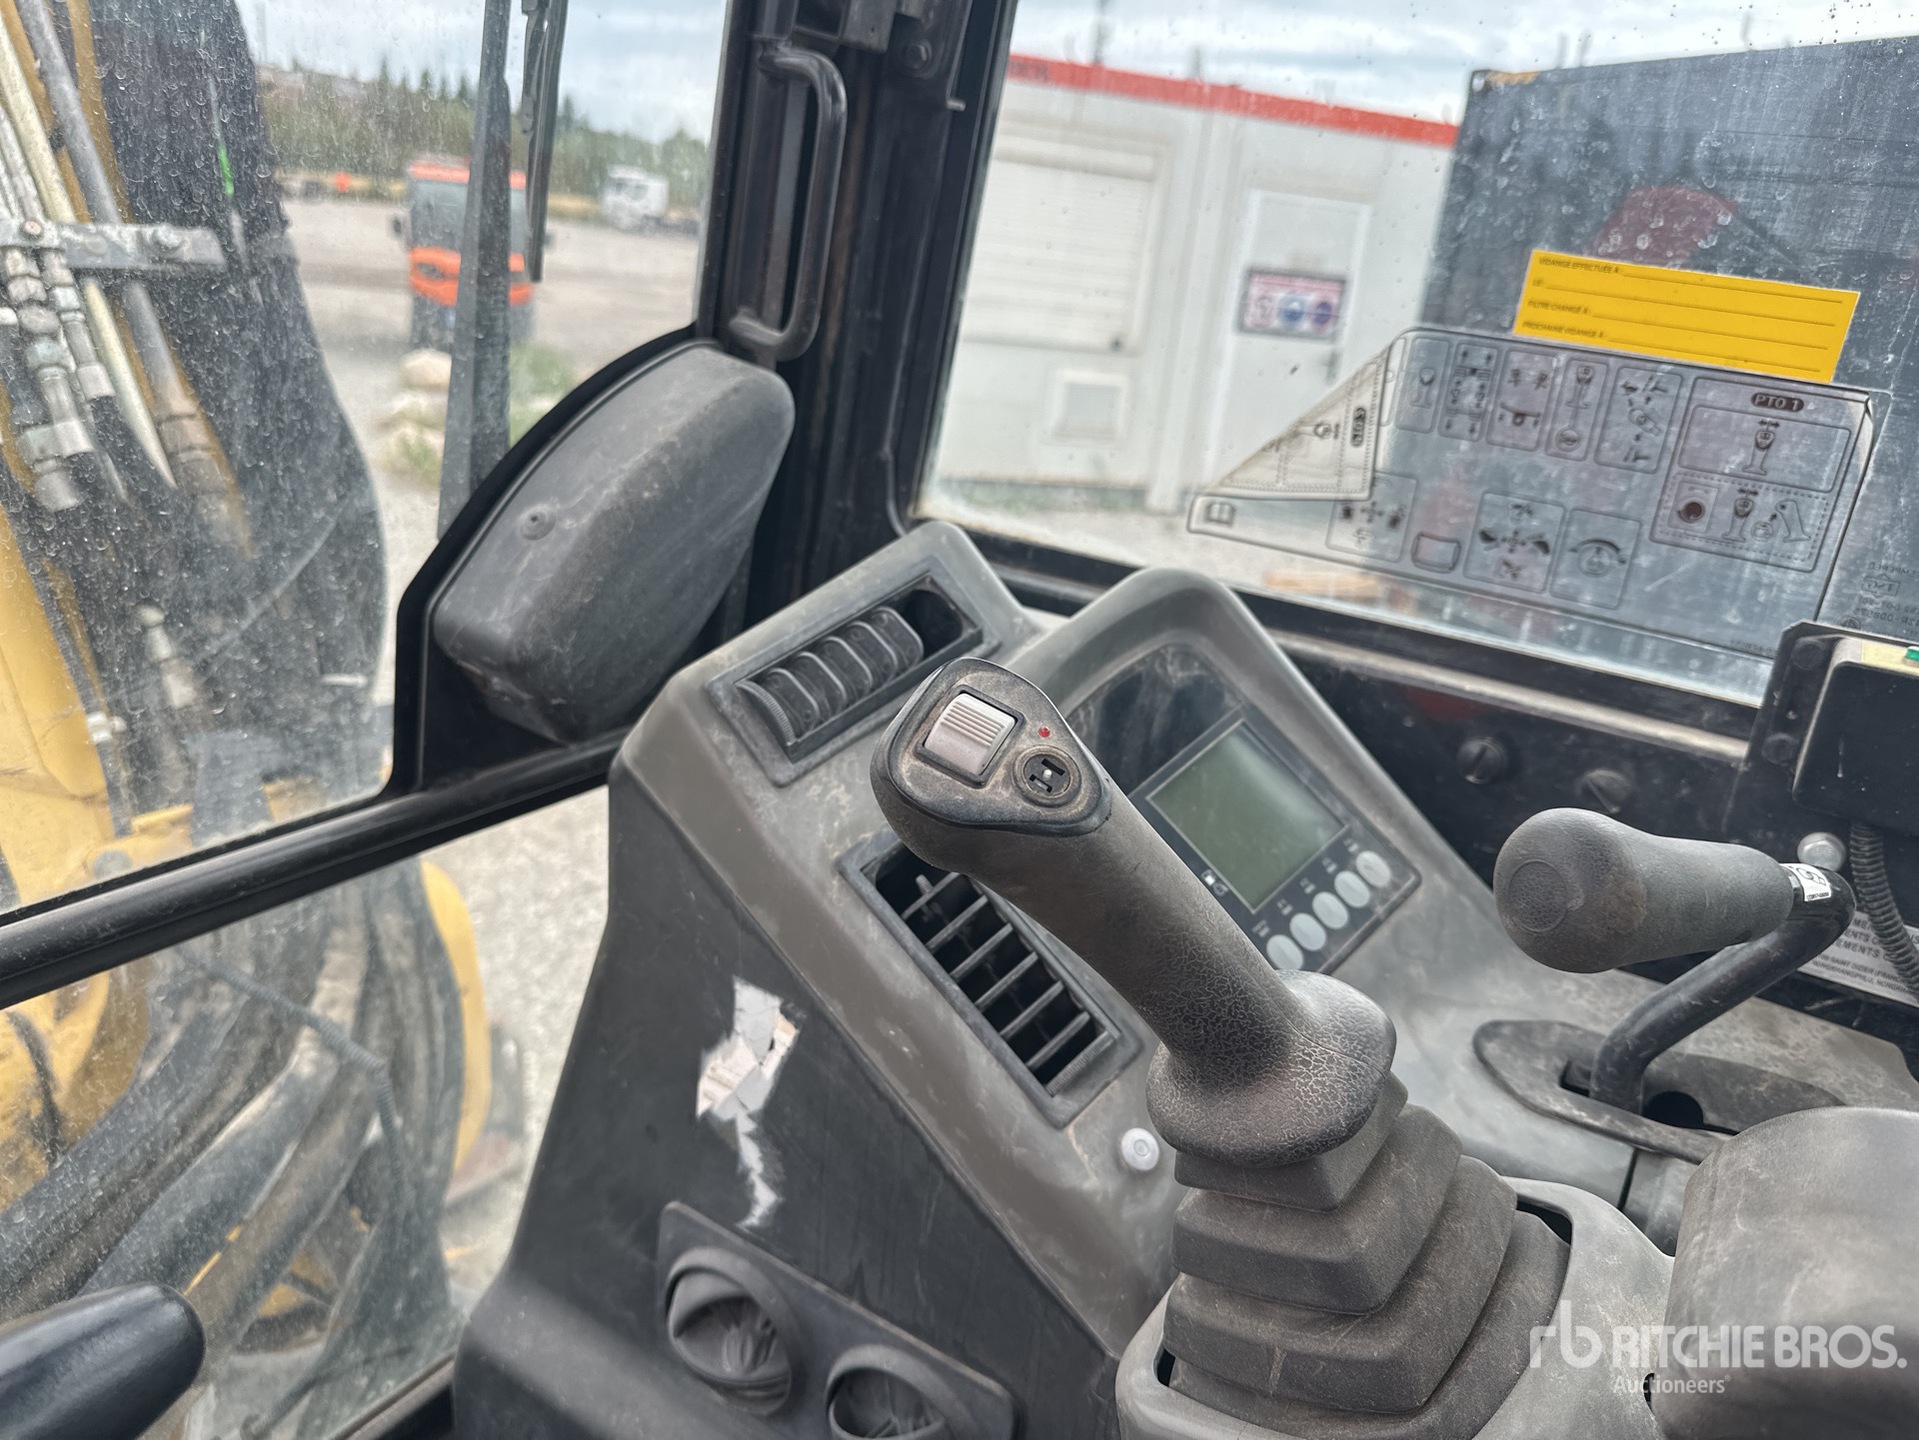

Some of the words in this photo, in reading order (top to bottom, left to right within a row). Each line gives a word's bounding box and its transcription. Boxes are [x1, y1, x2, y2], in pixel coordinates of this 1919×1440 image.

[1754, 394, 1787, 409] PTO
[1791, 399, 1800, 411] 1
[1835, 938, 1880, 958] EMENTS
